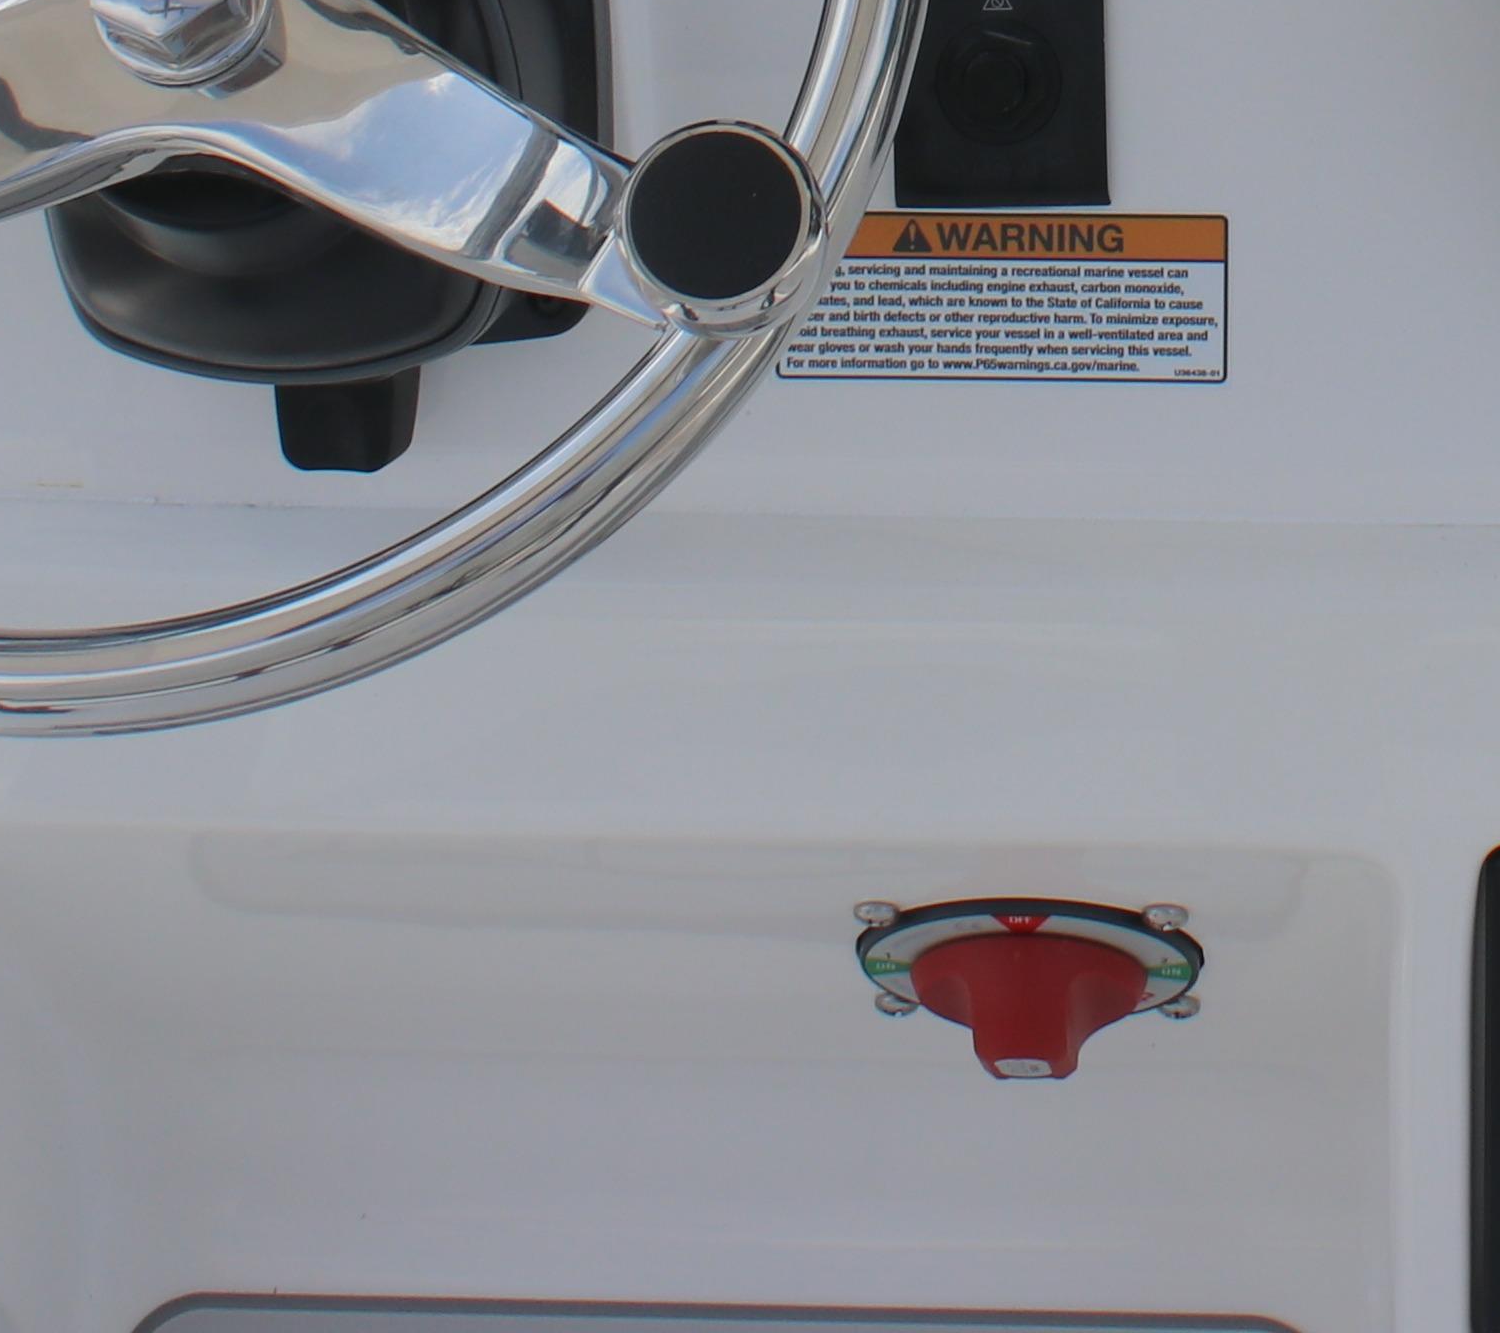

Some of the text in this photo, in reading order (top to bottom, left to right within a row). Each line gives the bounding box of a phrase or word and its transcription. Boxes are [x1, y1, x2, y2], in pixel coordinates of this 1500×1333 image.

[936, 222, 1125, 254] WARNING
[847, 263, 901, 278] servicing
[903, 264, 926, 276] and
[928, 264, 998, 279] maintaining
[1000, 267, 1009, 277] a
[1011, 265, 1082, 278] recreational
[1083, 266, 1125, 279] marine
[1127, 266, 1165, 279] vessel
[1166, 269, 1189, 279] can
[829, 279, 1185, 298] you to chemicals including engine exhaust, carbon monoxide,
[786, 356, 806, 369] For
[807, 359, 838, 369] more
[840, 356, 908, 370] information
[909, 359, 925, 372] go
[927, 358, 940, 370] to
